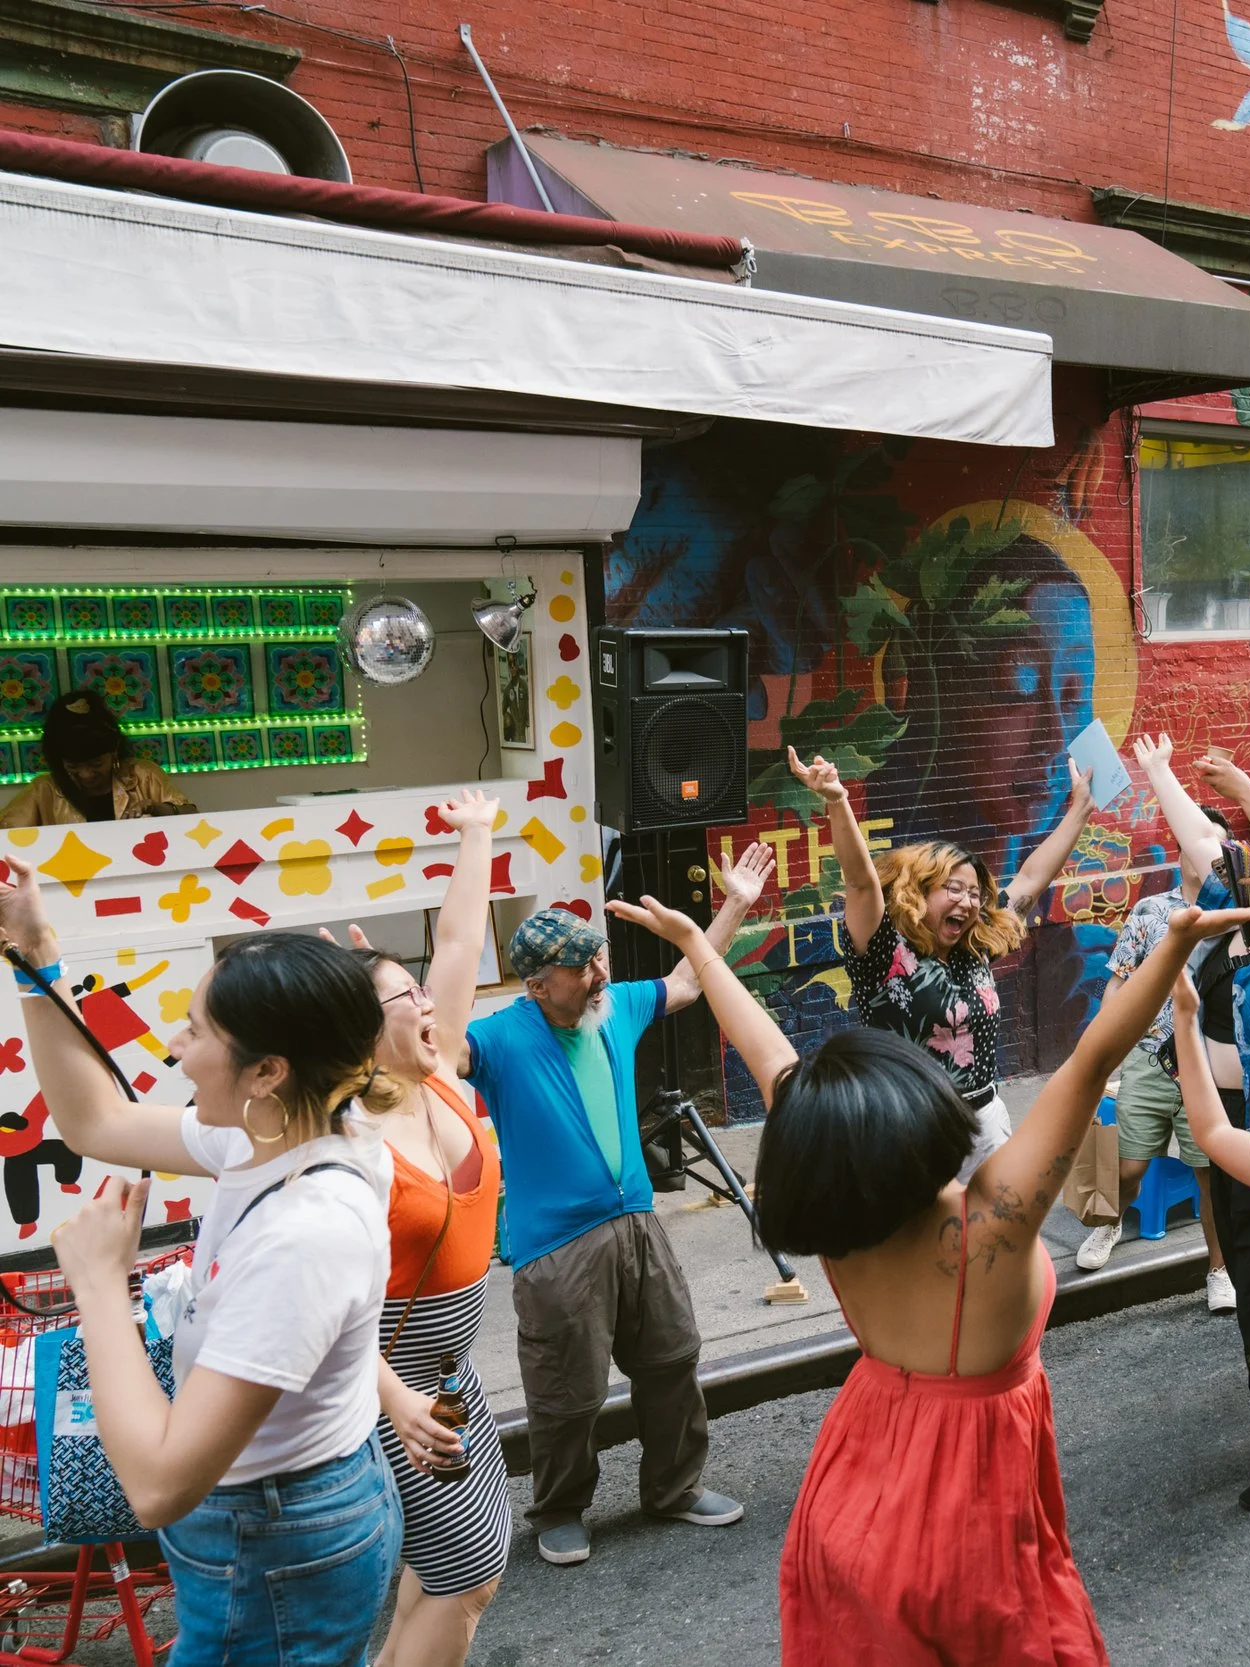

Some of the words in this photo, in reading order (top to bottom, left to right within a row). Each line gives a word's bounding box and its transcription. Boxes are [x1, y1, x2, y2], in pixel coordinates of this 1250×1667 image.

[830, 229, 1085, 274] EXPRESS
[602, 652, 615, 675] JBL
[759, 817, 894, 889] THE
